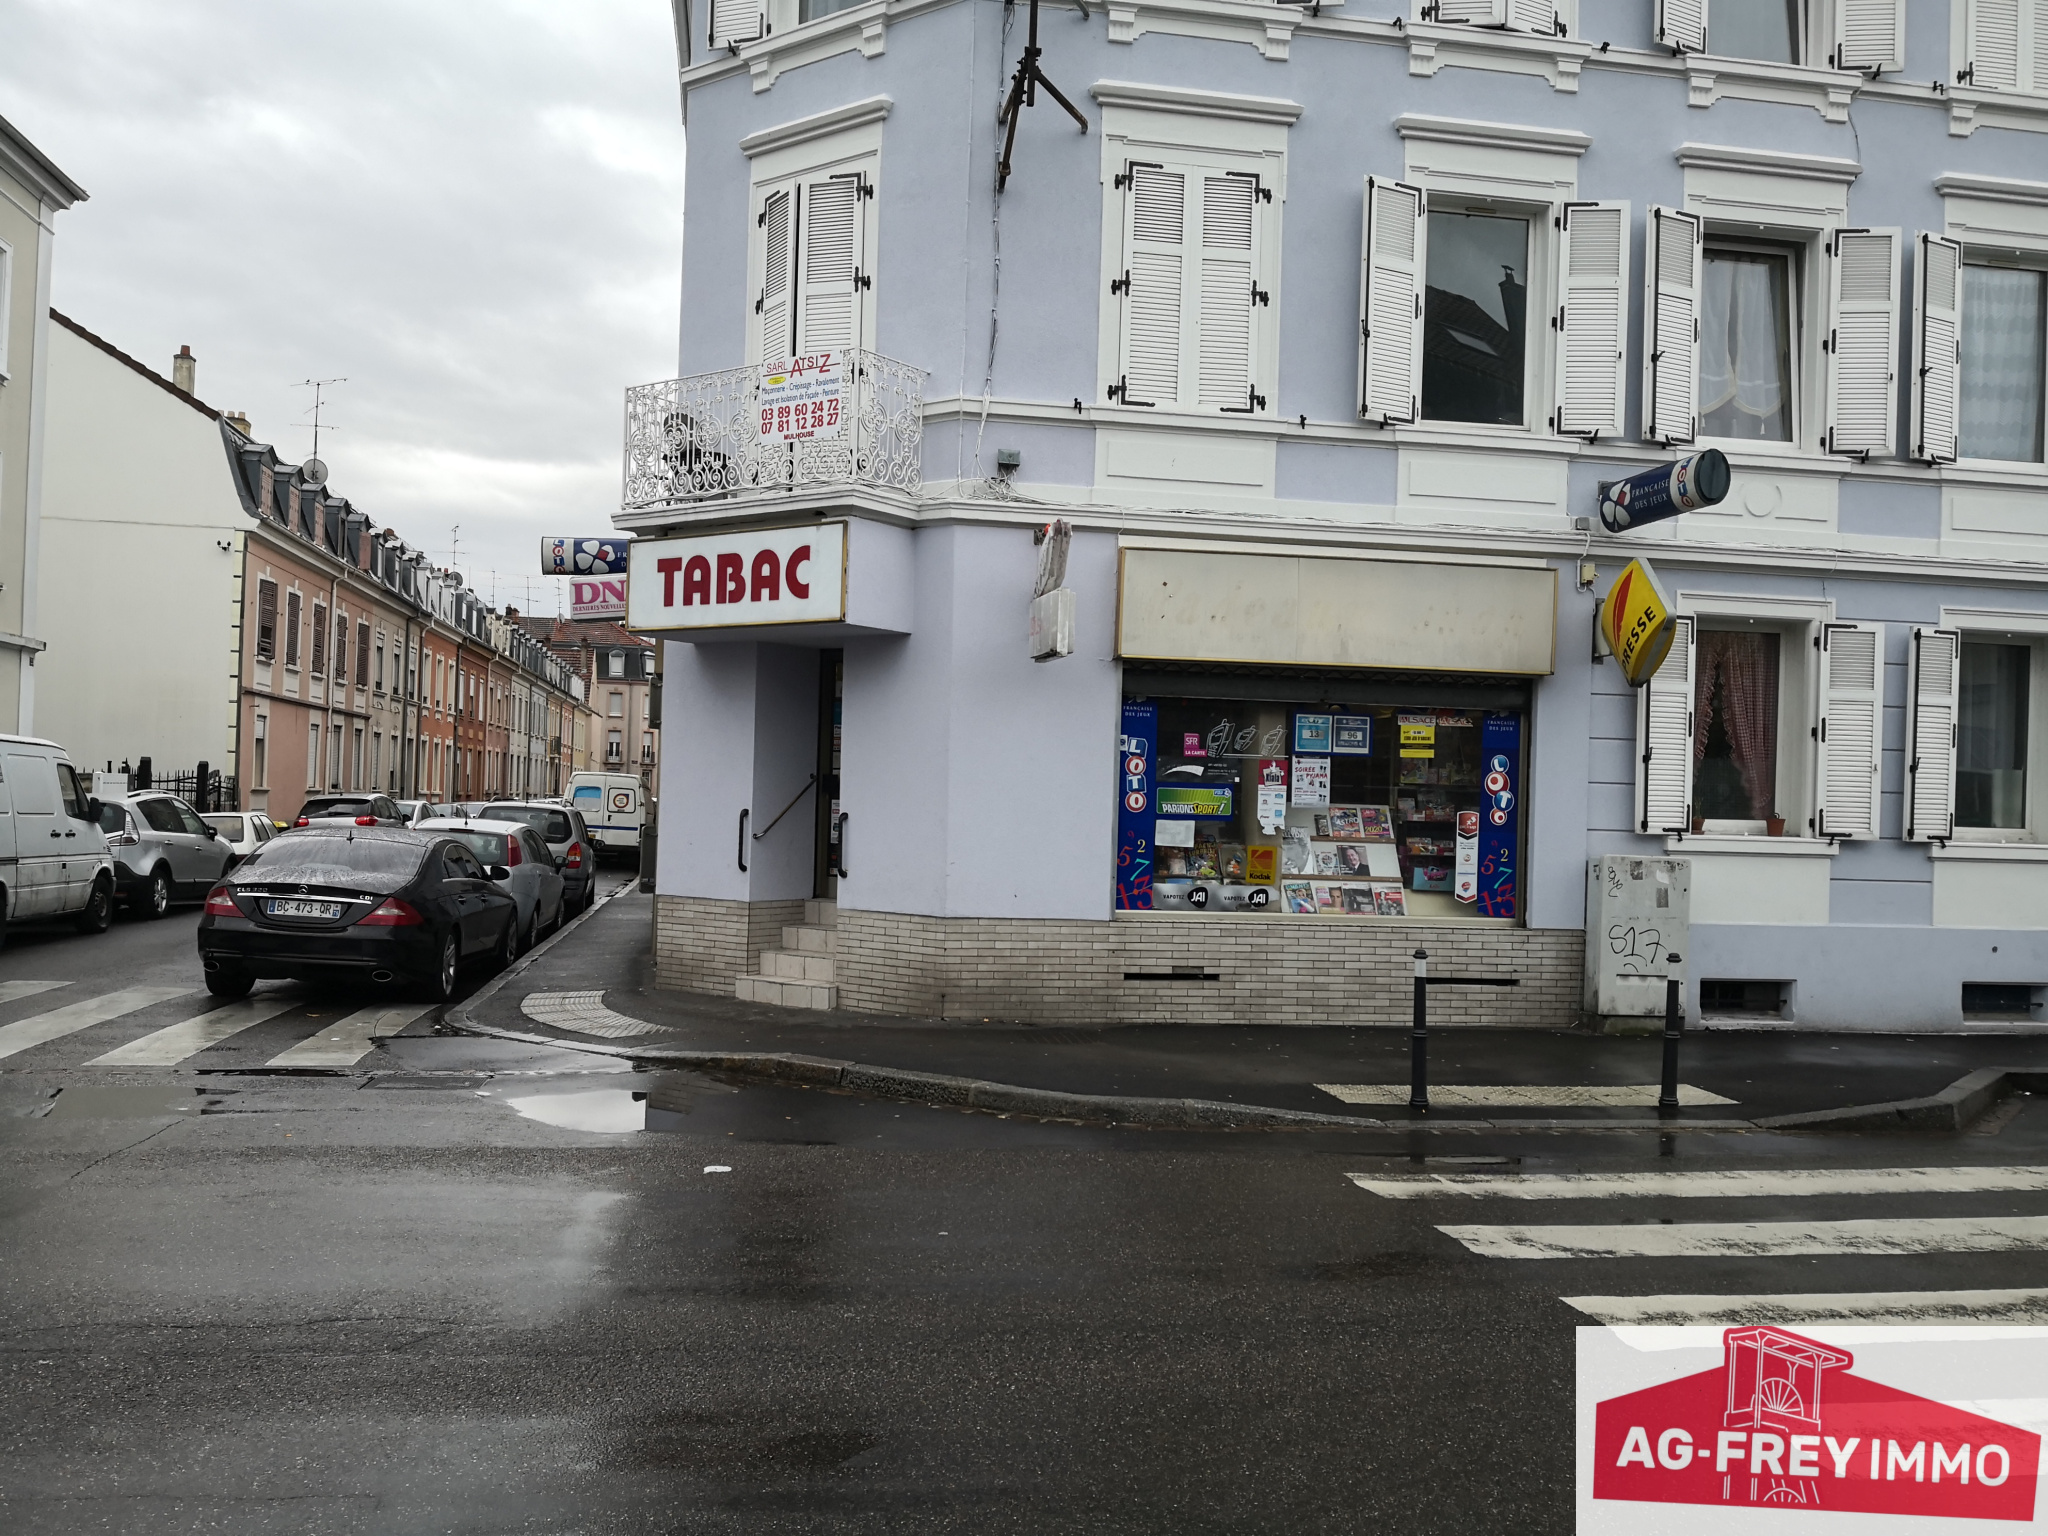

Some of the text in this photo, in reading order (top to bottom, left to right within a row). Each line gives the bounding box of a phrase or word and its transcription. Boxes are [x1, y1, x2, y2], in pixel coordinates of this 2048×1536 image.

[767, 354, 830, 378] SARL ATSIZ
[816, 377, 839, 386] Ravalement
[822, 388, 839, 396] Peinture
[761, 398, 839, 421] 03 89 60 24 72
[761, 412, 839, 434] 07 81 12 28 27
[784, 430, 814, 440] MULHOUSE
[1676, 456, 1694, 508] LOTO
[1635, 493, 1668, 510] DES JEUX
[657, 544, 811, 608] TABAC
[1621, 606, 1657, 675] PRESSE
[1127, 738, 1146, 811] LOTO
[1487, 757, 1512, 824] LOTO
[1117, 846, 1133, 866] 5
[1137, 839, 1146, 853] 2
[1501, 848, 1508, 861] 2
[1130, 858, 1150, 881] 7
[1481, 855, 1496, 874] 5
[1493, 867, 1513, 889] 7
[1191, 892, 1205, 902] JAI
[1251, 894, 1266, 904] JAI
[276, 901, 332, 915] BC-473-QR
